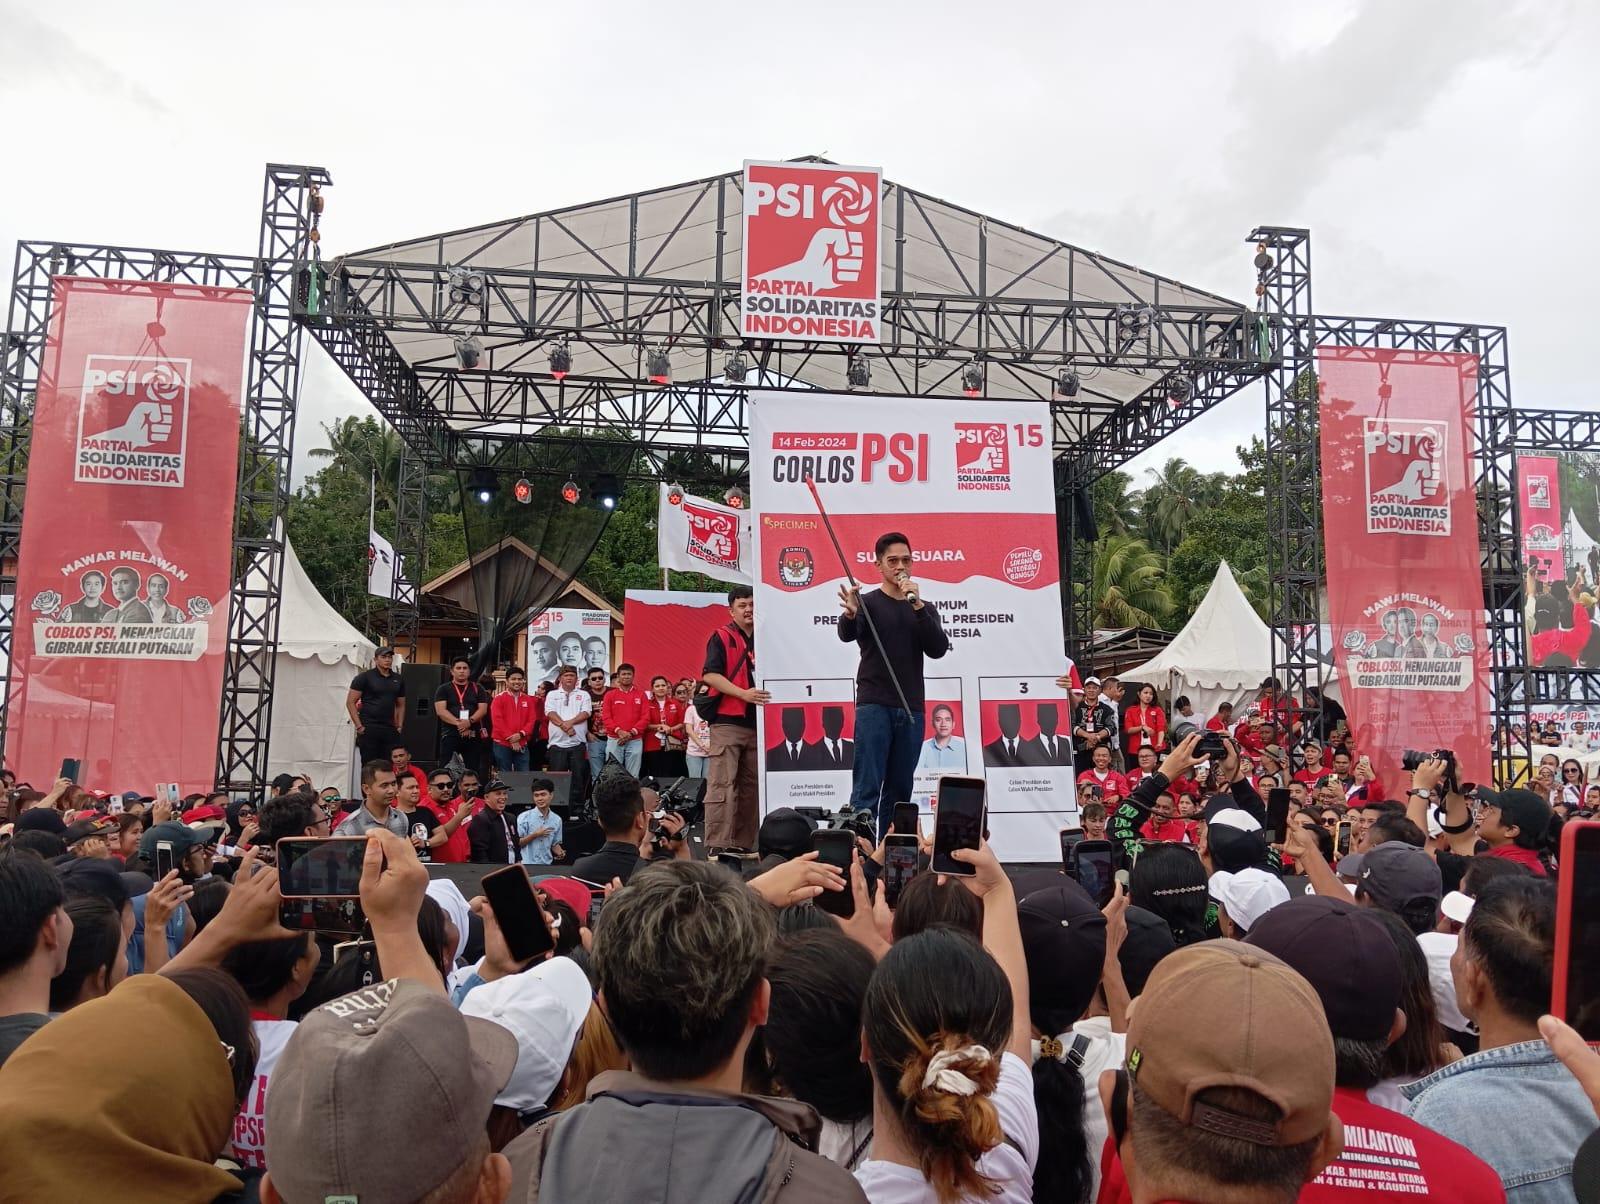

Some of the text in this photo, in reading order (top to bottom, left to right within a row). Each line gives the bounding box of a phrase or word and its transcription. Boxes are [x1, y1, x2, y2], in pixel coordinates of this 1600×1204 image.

[748, 182, 814, 219] PSI
[747, 279, 813, 296] PARTAI
[746, 296, 876, 318] SOLIDARITAS
[745, 314, 875, 338] INDONESIA
[87, 367, 137, 396] PSI
[779, 437, 847, 447] 14 Feb 2024
[955, 423, 1044, 448] PSI 15
[1367, 431, 1411, 455] PSI
[80, 439, 133, 452] PARTAI
[79, 451, 181, 469] SOLIDARITAS
[773, 432, 929, 484] COBLOS PSI
[79, 465, 180, 483] INDONESIA
[957, 475, 1011, 483] SOLIDARITAS
[957, 482, 1011, 491] INDONESIA
[769, 519, 818, 530] SPECIMEN
[911, 550, 965, 562] SUARA
[61, 550, 190, 582] MAWAR MELAWAN
[1401, 592, 1455, 620] MELAWAN
[552, 612, 564, 622] 15
[952, 614, 1014, 624] PRESIDEN
[45, 626, 196, 640] COBLOS PSI, MENANGKAN
[943, 628, 982, 638] NESIA
[45, 641, 193, 655] GIBRAN SEKALI PUTARAN
[1405, 661, 1462, 673] MENANGKAN
[1019, 682, 1029, 694] 3
[1417, 674, 1462, 687] PUTARAN
[805, 685, 813, 697] 1
[1343, 1124, 1417, 1158] MILANTOW
[1341, 1151, 1420, 1170] MINAHASA UTARA
[1326, 1165, 1427, 1185] KAB. MINAHASA UTARA
[1326, 1176, 1333, 1185] 4
[1336, 1178, 1365, 1189] KEMA
[1367, 1181, 1376, 1189] &
[1378, 1182, 1429, 1194] KAUDITAN
